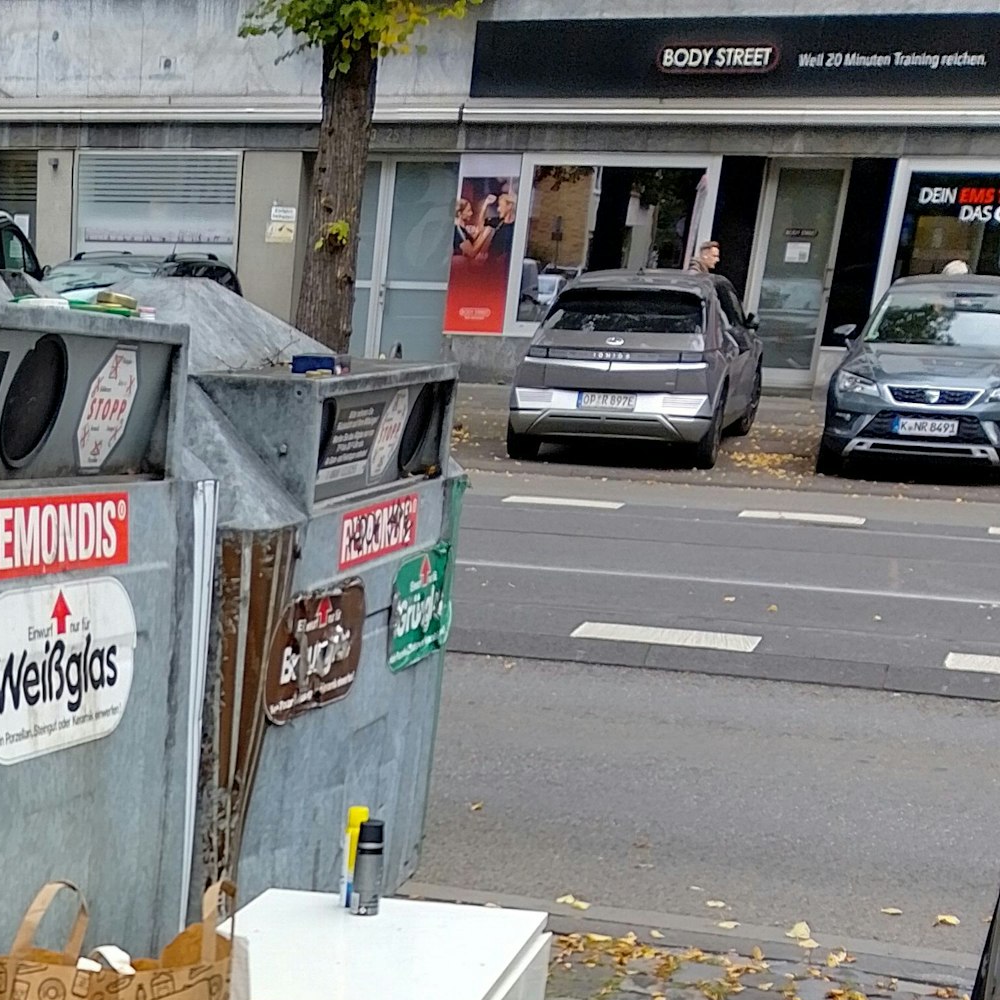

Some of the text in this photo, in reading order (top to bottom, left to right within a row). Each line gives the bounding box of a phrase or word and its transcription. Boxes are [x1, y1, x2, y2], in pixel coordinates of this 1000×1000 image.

[662, 47, 773, 68] BODY STREET
[799, 53, 824, 67] Weil
[825, 53, 843, 67] 20
[843, 53, 891, 67] Minuten
[893, 52, 940, 69] Training
[919, 187, 995, 204] DEIN EMS
[959, 205, 993, 222] DAS
[87, 398, 127, 421] STOPP
[28, 617, 91, 641] Einwurf nur für
[58, 718, 71, 729] oder
[72, 711, 94, 726] Keramik
